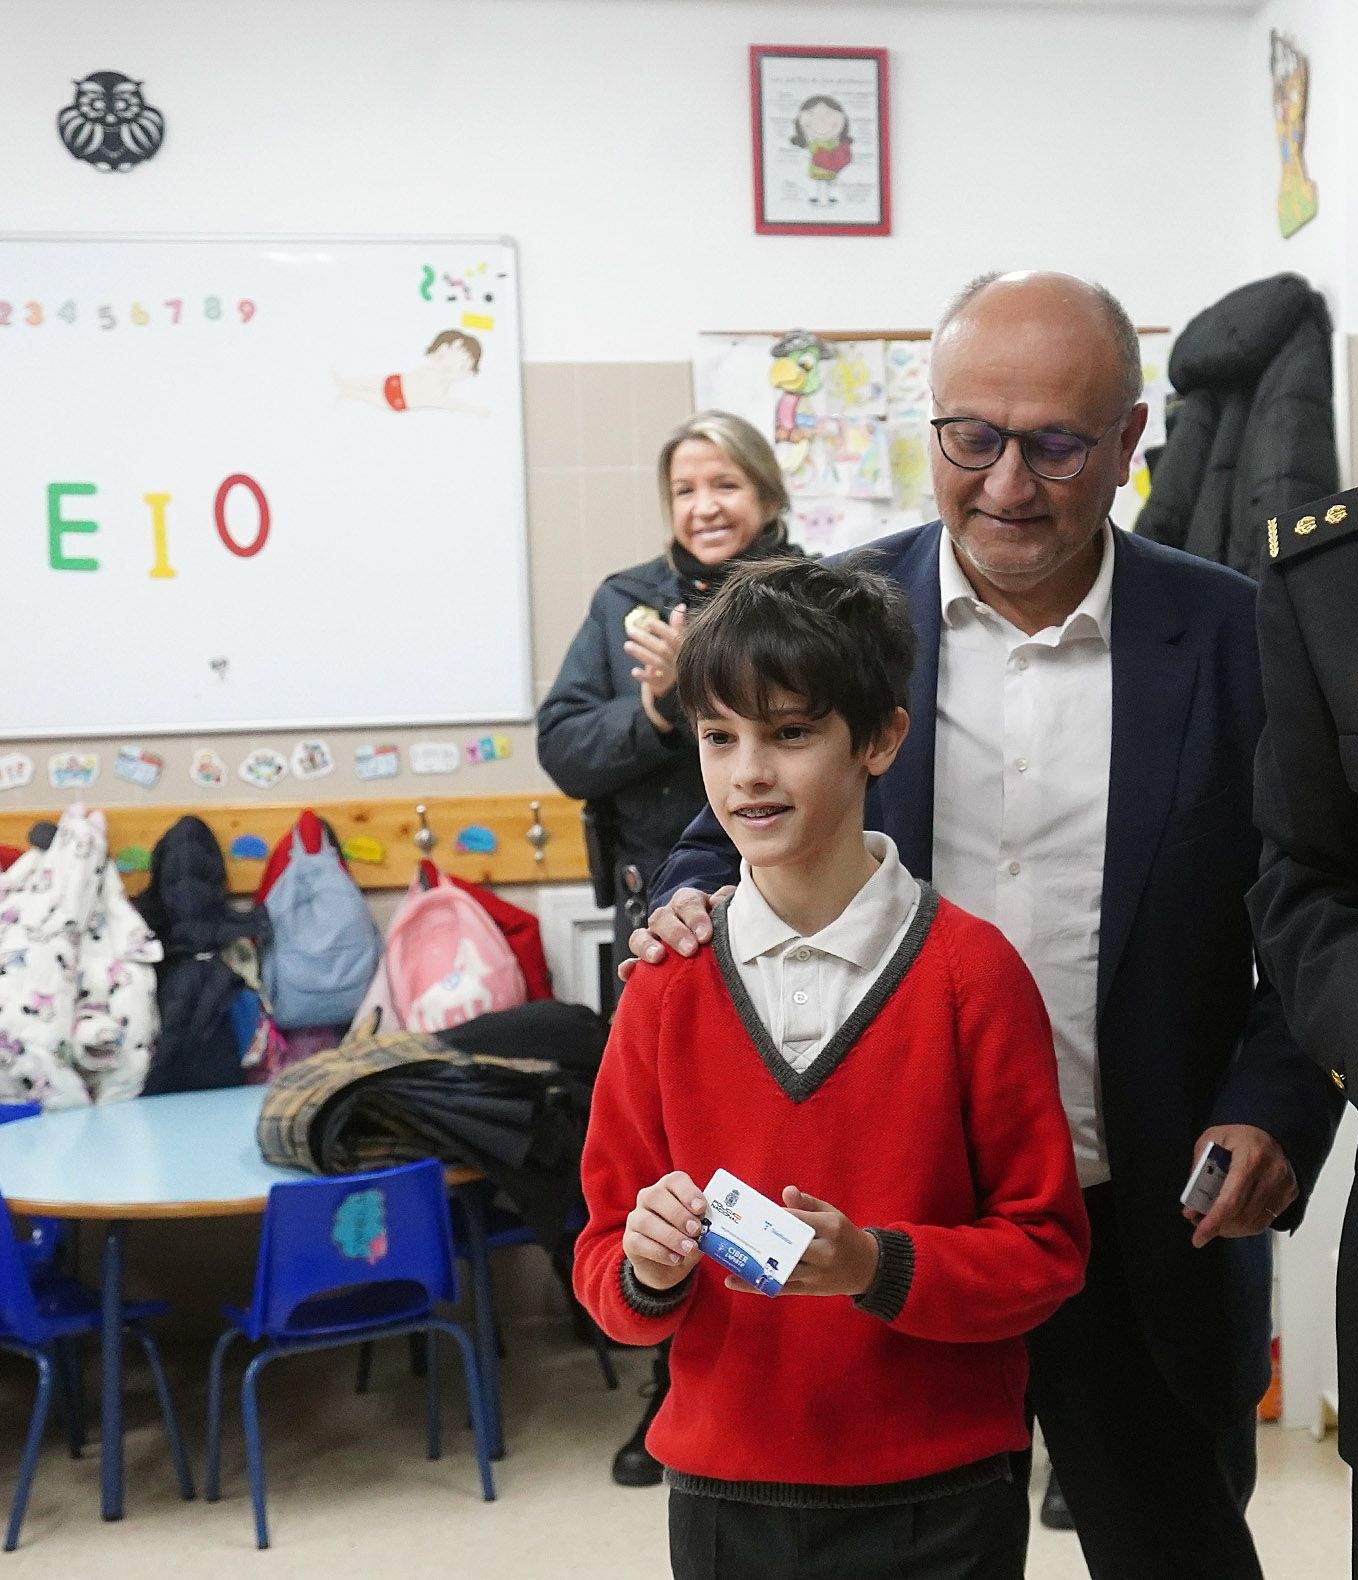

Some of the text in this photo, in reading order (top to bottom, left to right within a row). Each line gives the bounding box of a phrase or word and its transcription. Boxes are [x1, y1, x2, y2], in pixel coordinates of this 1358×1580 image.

[25, 300, 43, 327] 3
[57, 300, 76, 324] 4
[97, 304, 117, 330] 5
[130, 302, 150, 326] 6
[163, 299, 182, 324] 7
[203, 296, 221, 321] 8
[238, 299, 256, 323] 9
[46, 472, 272, 579] E I O
[728, 1246, 749, 1262] CIBER
